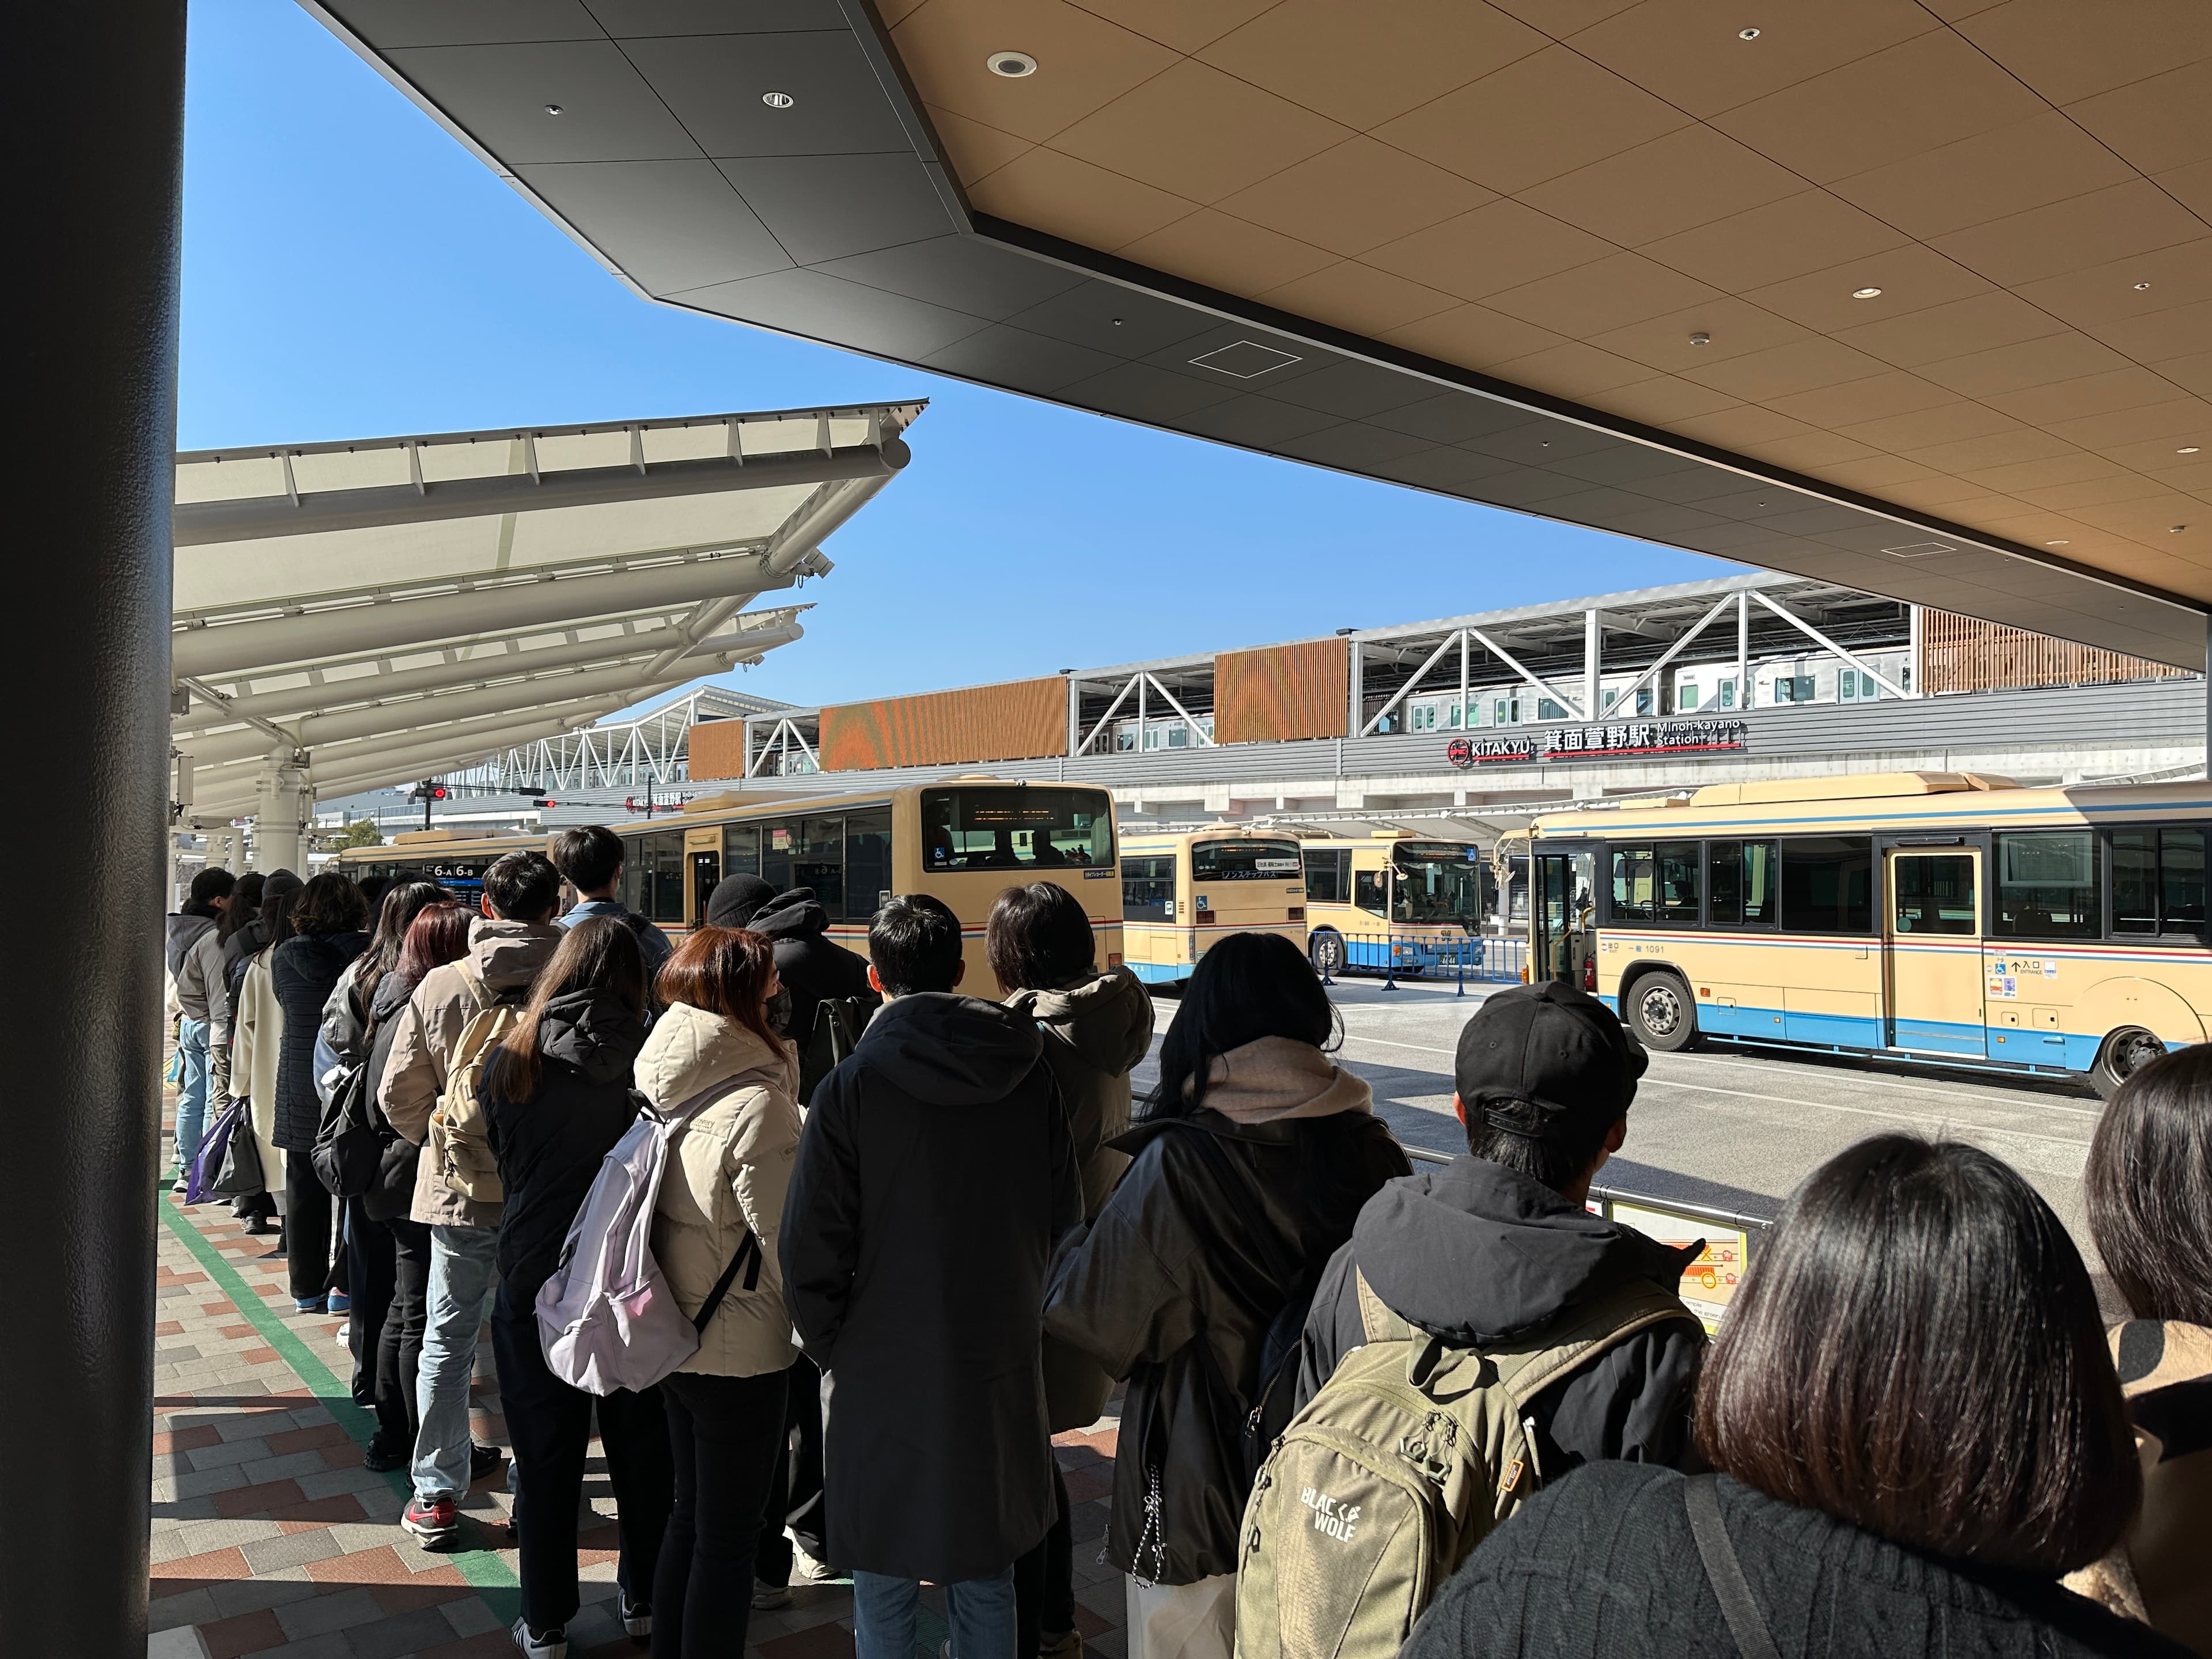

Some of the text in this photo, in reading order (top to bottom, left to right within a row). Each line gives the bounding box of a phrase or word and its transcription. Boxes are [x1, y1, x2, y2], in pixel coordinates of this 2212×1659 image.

[1657, 720, 1740, 732] Minoh-kayano
[1543, 724, 1650, 751] 箕面萱野駅
[1657, 734, 1699, 745] Station
[1472, 740, 1530, 756] KITAKYU
[434, 865, 452, 876] 6-A
[456, 865, 474, 876] 6-B
[2022, 961, 2040, 969] 入口
[1314, 1510, 1357, 1543] WOLF
